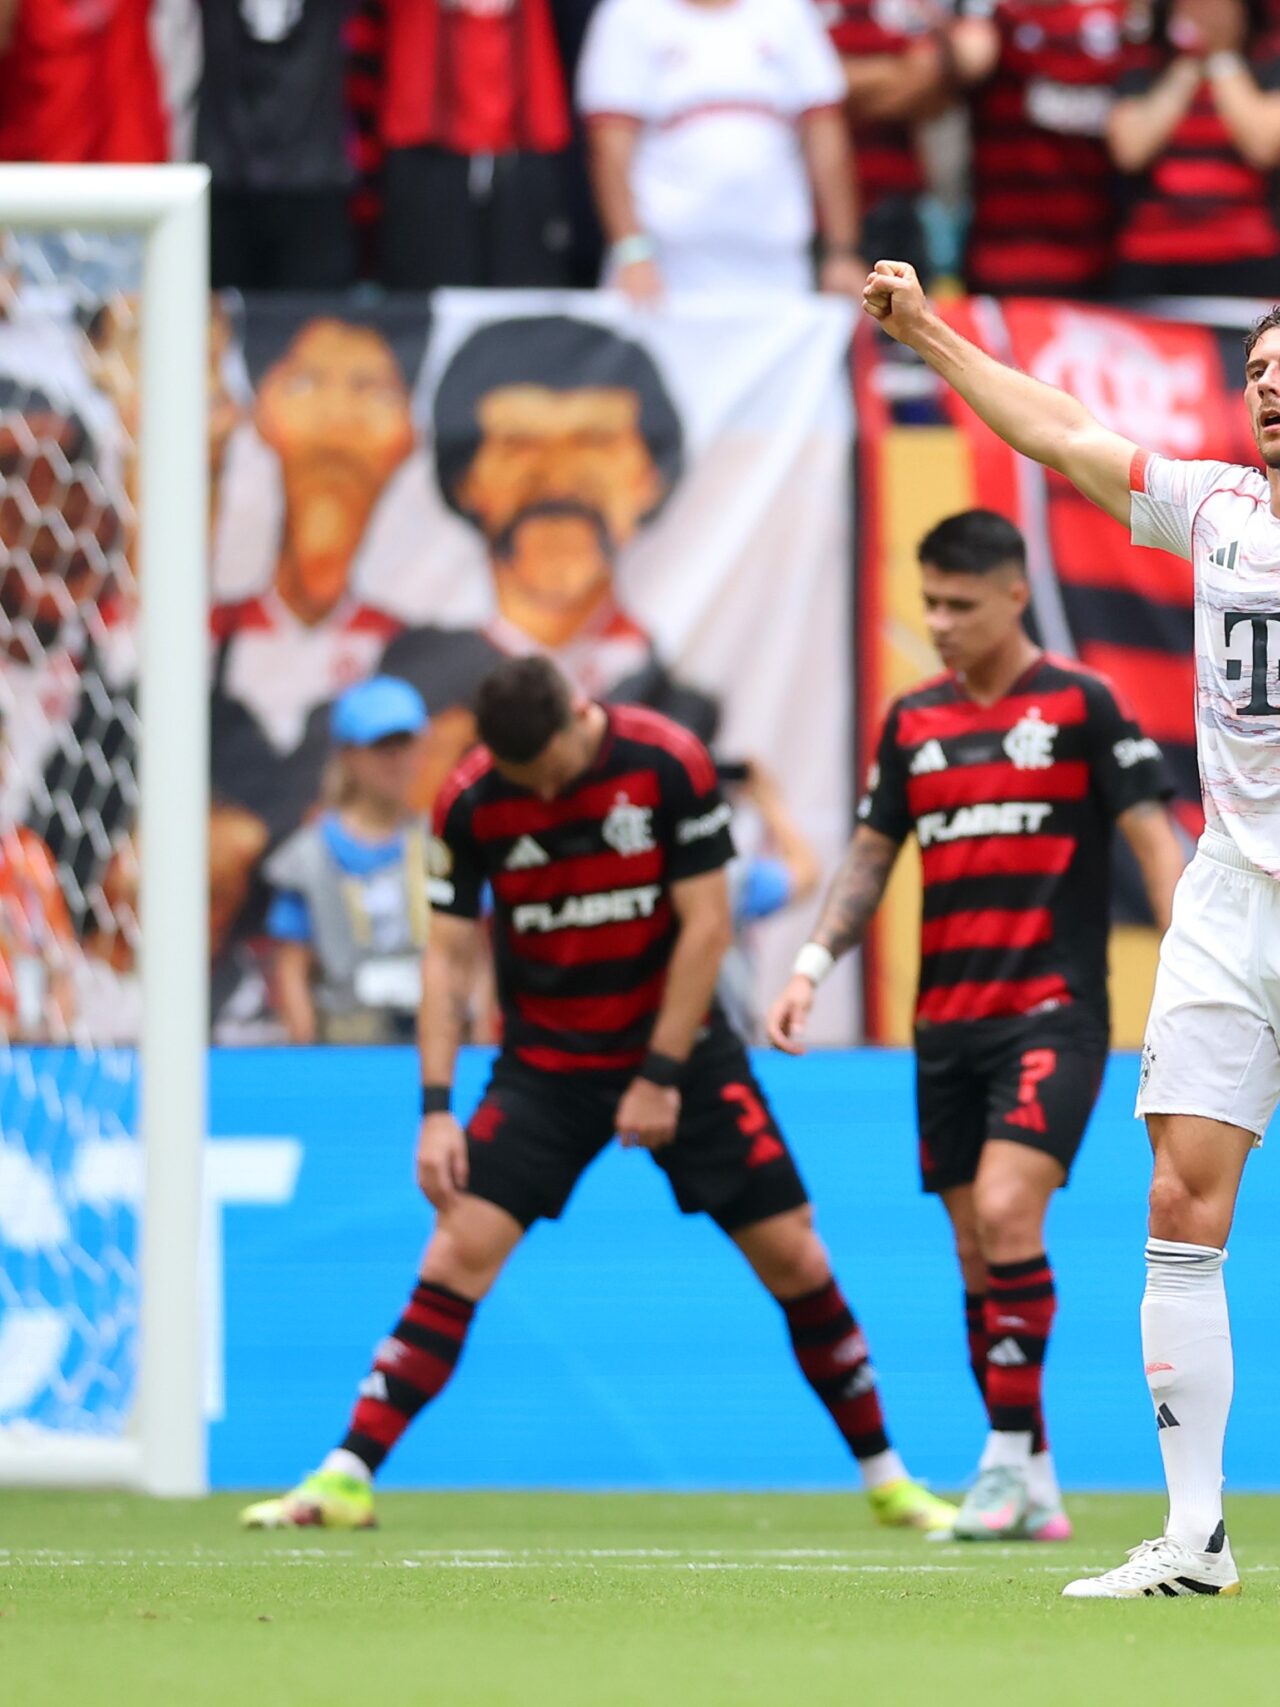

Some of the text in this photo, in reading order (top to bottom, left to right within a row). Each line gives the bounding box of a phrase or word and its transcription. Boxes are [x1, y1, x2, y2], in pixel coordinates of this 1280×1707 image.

[917, 802, 1053, 846] FLABET
[512, 885, 661, 932] FLABET
[721, 1081, 767, 1136] 3
